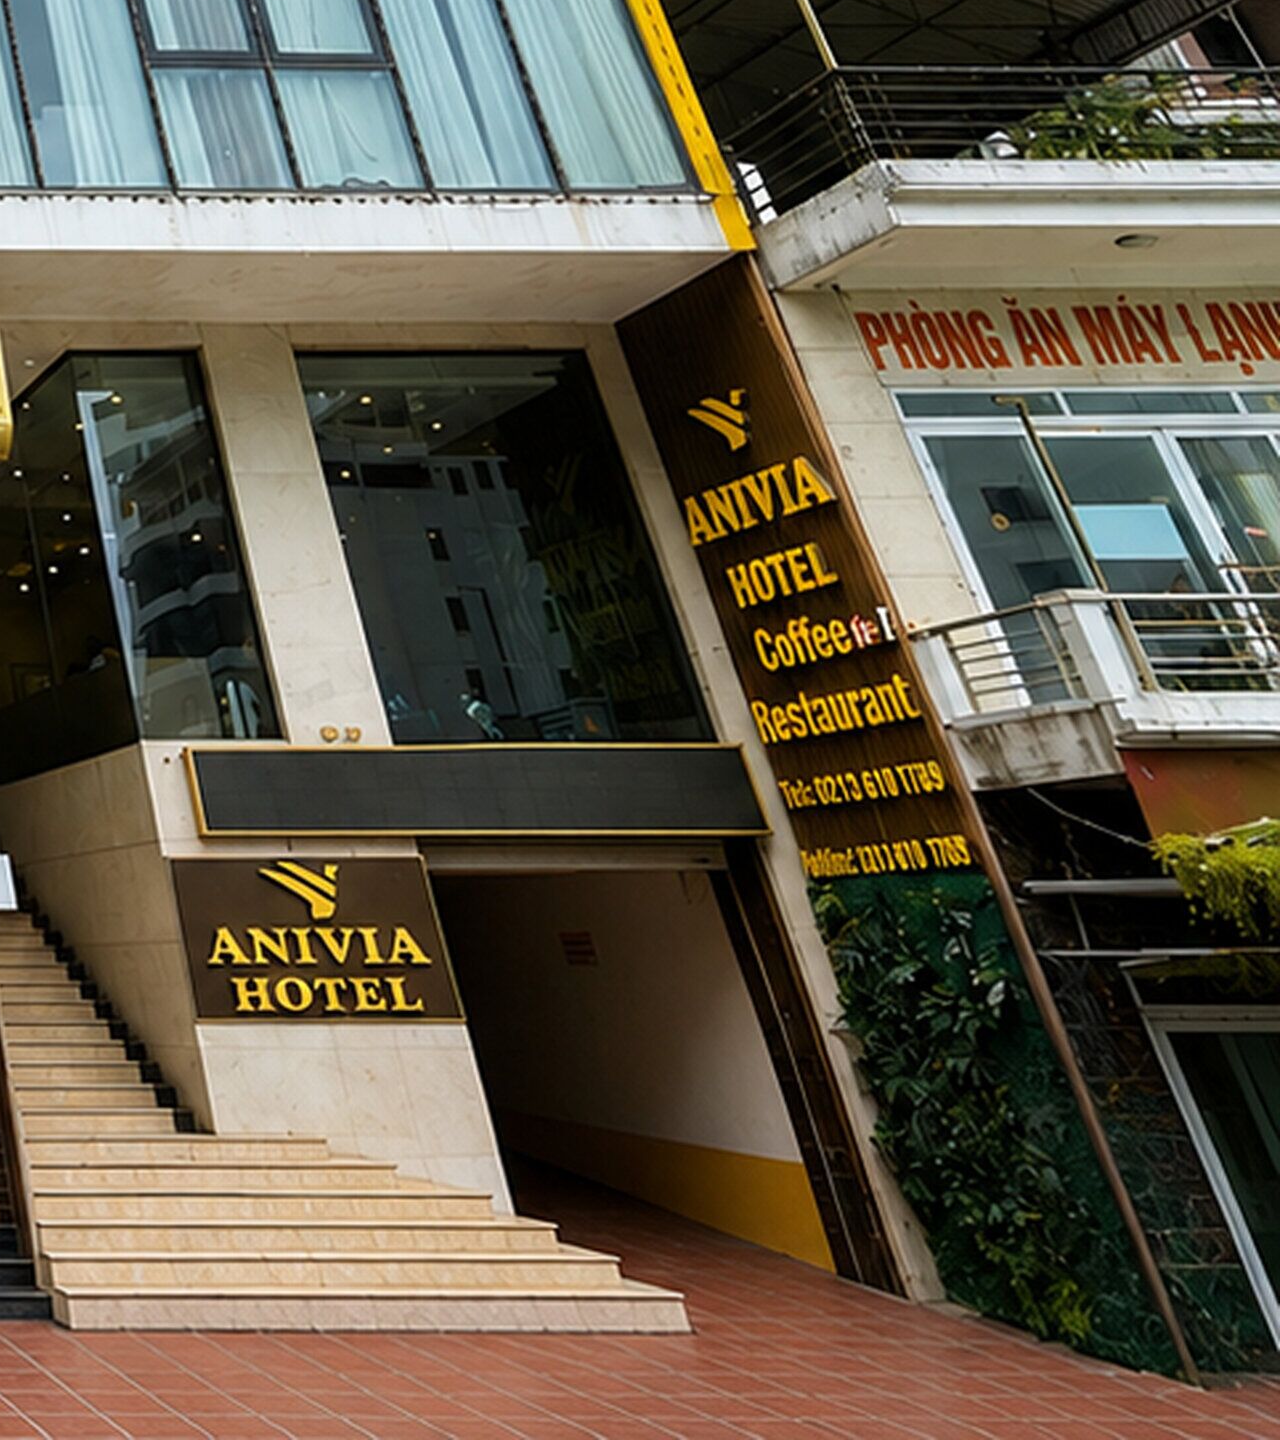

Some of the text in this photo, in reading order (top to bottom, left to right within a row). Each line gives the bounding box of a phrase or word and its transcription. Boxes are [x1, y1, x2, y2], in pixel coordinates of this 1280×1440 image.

[853, 300, 1012, 371] PHÒNG
[1002, 296, 1083, 366] ĂN
[1071, 294, 1183, 365] MÁY
[684, 456, 837, 546] ANIVIA
[726, 542, 839, 609] HOTEL
[753, 615, 853, 672] Coffee
[751, 673, 922, 745] Restaurant
[208, 927, 432, 965] ANIVIA
[231, 977, 425, 1012] HOTEL
